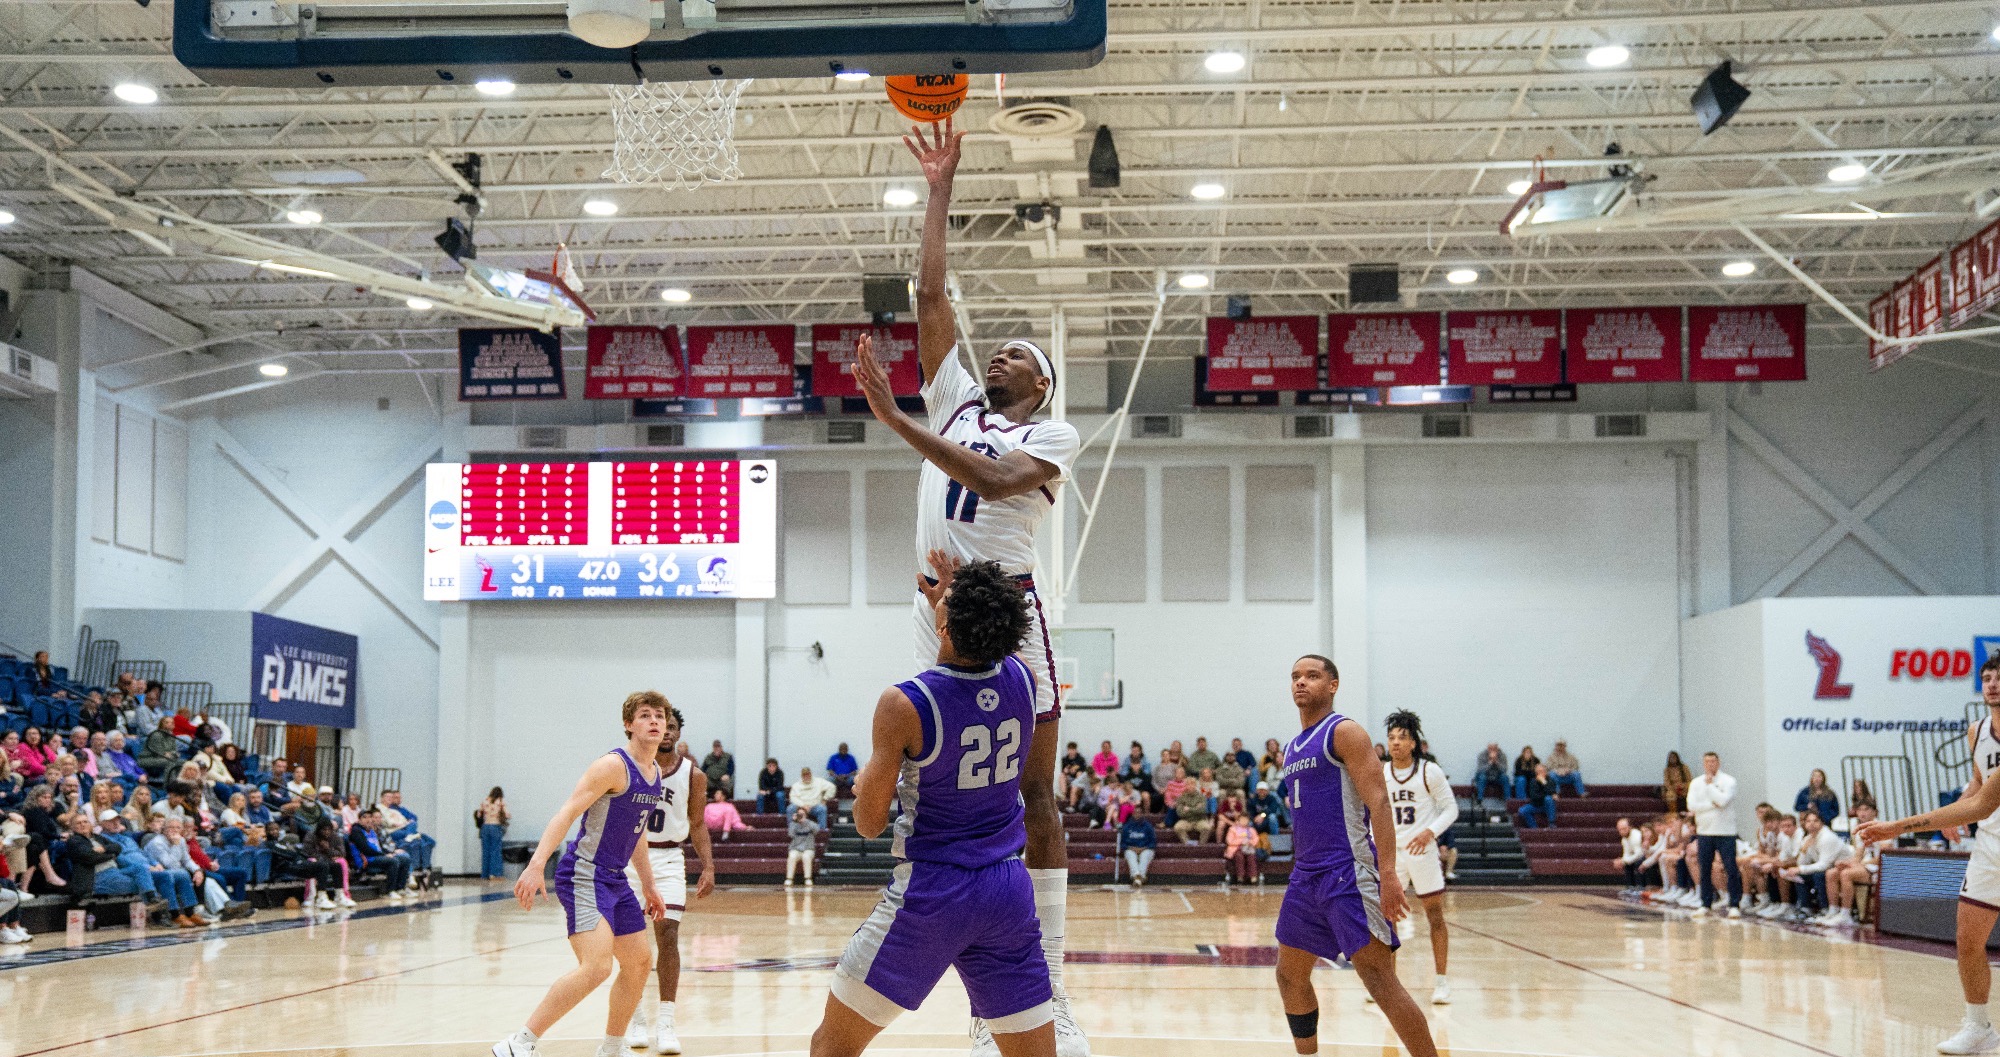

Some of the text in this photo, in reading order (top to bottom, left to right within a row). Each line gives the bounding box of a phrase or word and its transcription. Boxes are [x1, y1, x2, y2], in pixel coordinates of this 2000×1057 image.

[907, 96, 960, 115] Wilson
[511, 554, 544, 584] 31
[578, 560, 621, 580] 47.0
[638, 552, 680, 582] 36
[430, 577, 455, 587] LEE
[283, 645, 349, 671] LEE UNIVERSITY
[1890, 649, 1973, 680] FOOD
[261, 643, 348, 707] FLAMES
[1781, 716, 1969, 734] Official Supermarket
[957, 716, 1021, 790] 22
[1284, 756, 1317, 777] REVECCA
[1293, 777, 1302, 809] 1
[1391, 788, 1415, 803] LEE
[1394, 805, 1416, 825] 13
